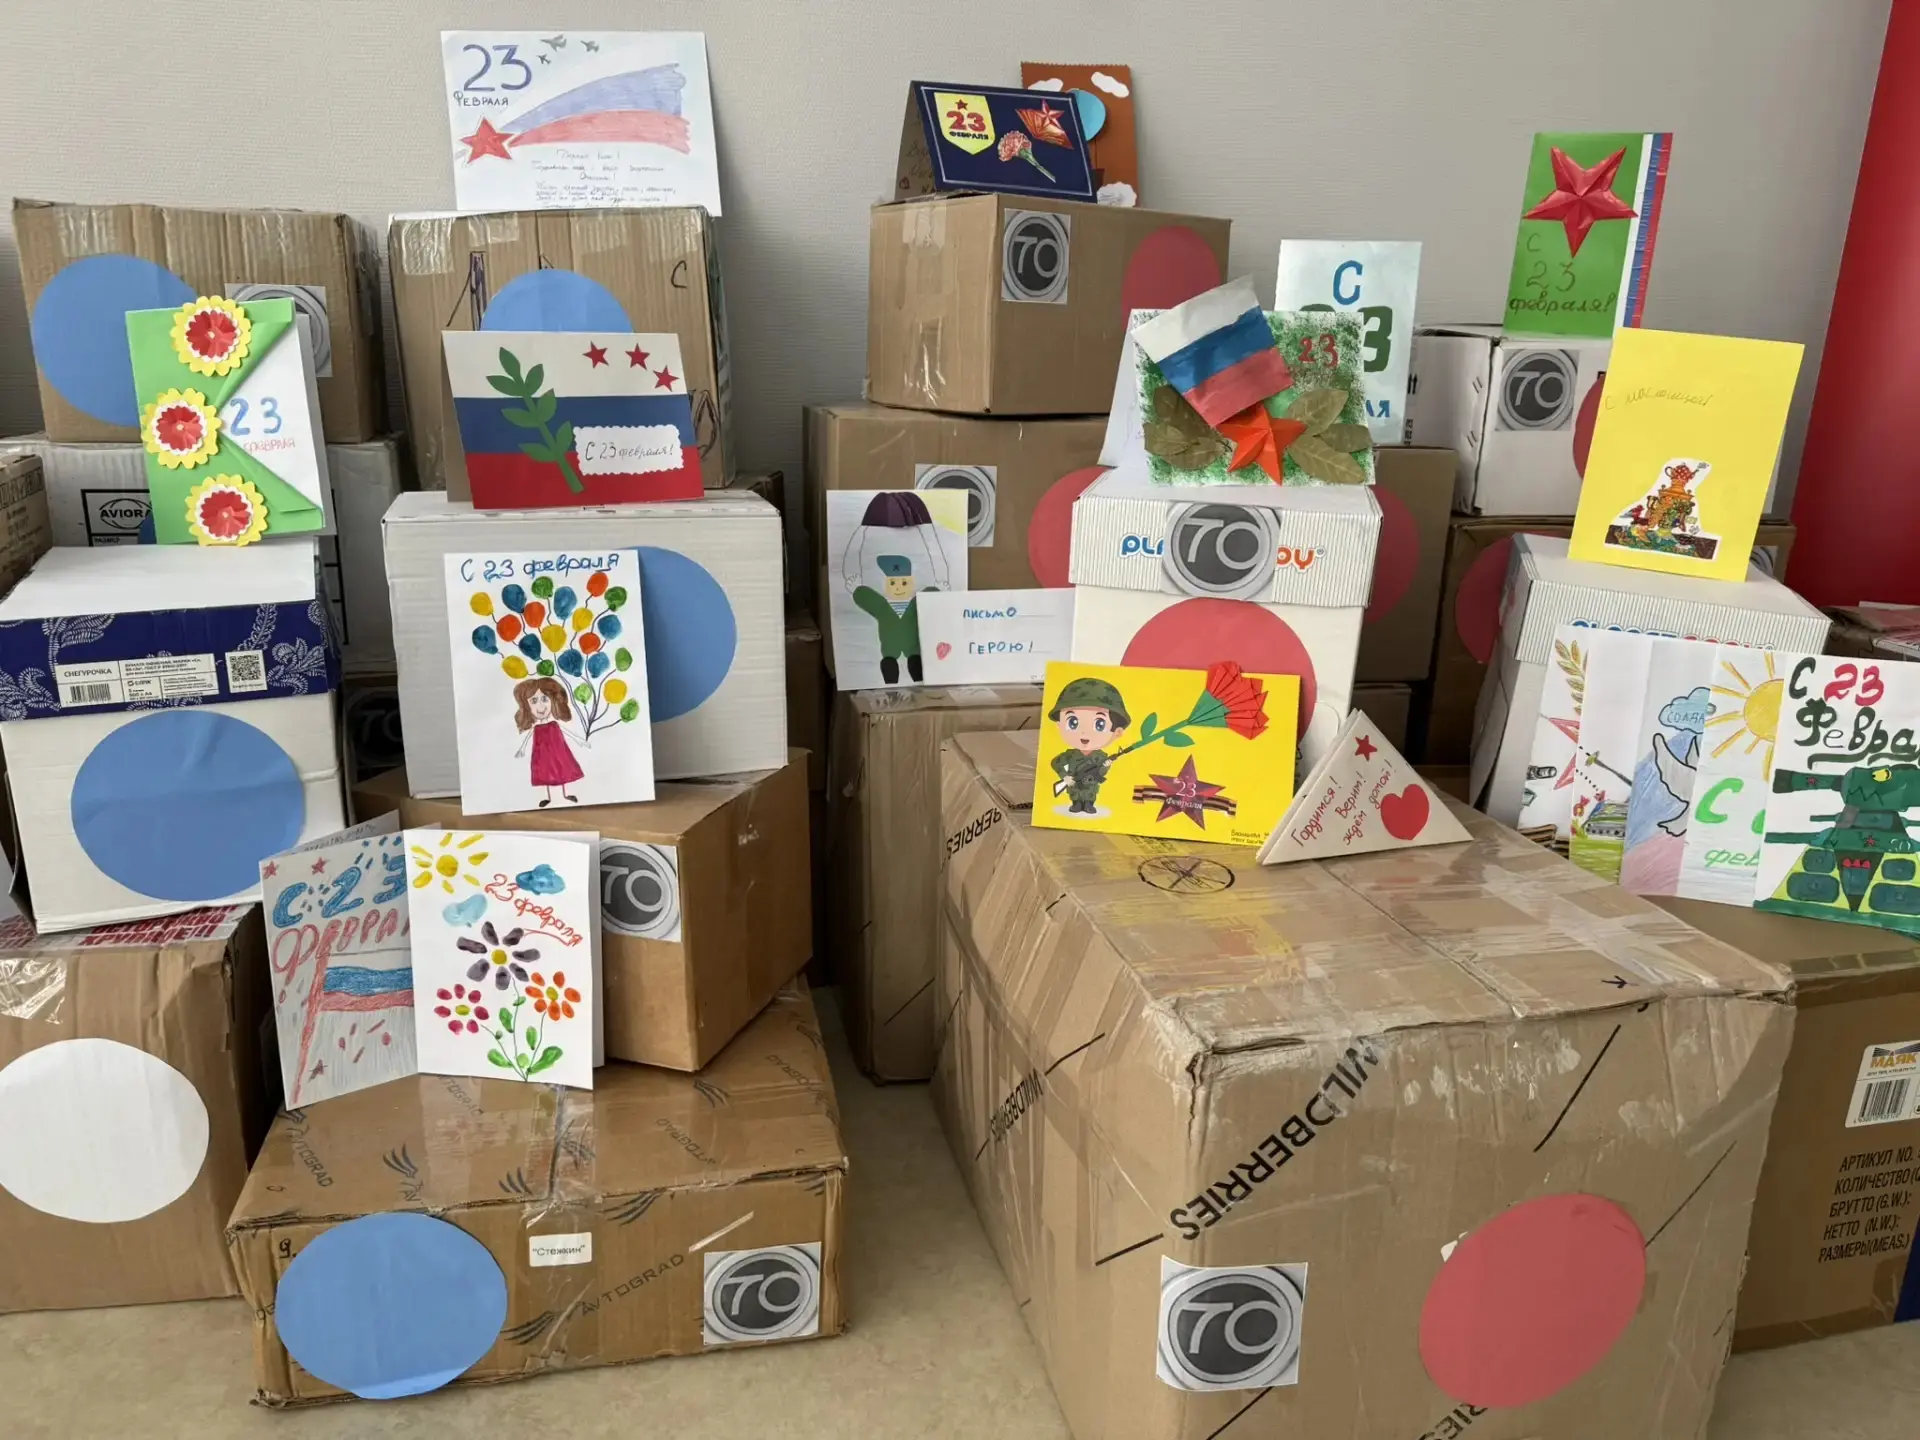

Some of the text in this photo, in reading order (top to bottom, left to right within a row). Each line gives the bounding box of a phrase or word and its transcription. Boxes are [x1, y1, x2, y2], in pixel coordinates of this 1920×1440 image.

[462, 44, 532, 91] 23
[946, 110, 986, 132] 23
[949, 131, 989, 140] ФЕВРАЛЯ
[1526, 261, 1576, 292] 23
[1299, 334, 1338, 367] 23
[230, 397, 282, 436] 23
[585, 441, 595, 461] С
[600, 441, 616, 460] 23
[1182, 517, 1261, 570] 70
[461, 558, 475, 583] С
[483, 558, 514, 583] 23
[64, 668, 113, 678] СНЕГУРОЧКА
[1824, 663, 1884, 706] 23
[1176, 780, 1198, 798] 23
[1166, 796, 1203, 810] Февраля
[1870, 1053, 1917, 1069] МАЯК
[1839, 1149, 1893, 1173] АРТИКУЛ
[1823, 1220, 1860, 1241] НЕТТО
[723, 1269, 804, 1316] 70
[1181, 1299, 1282, 1355] 70
